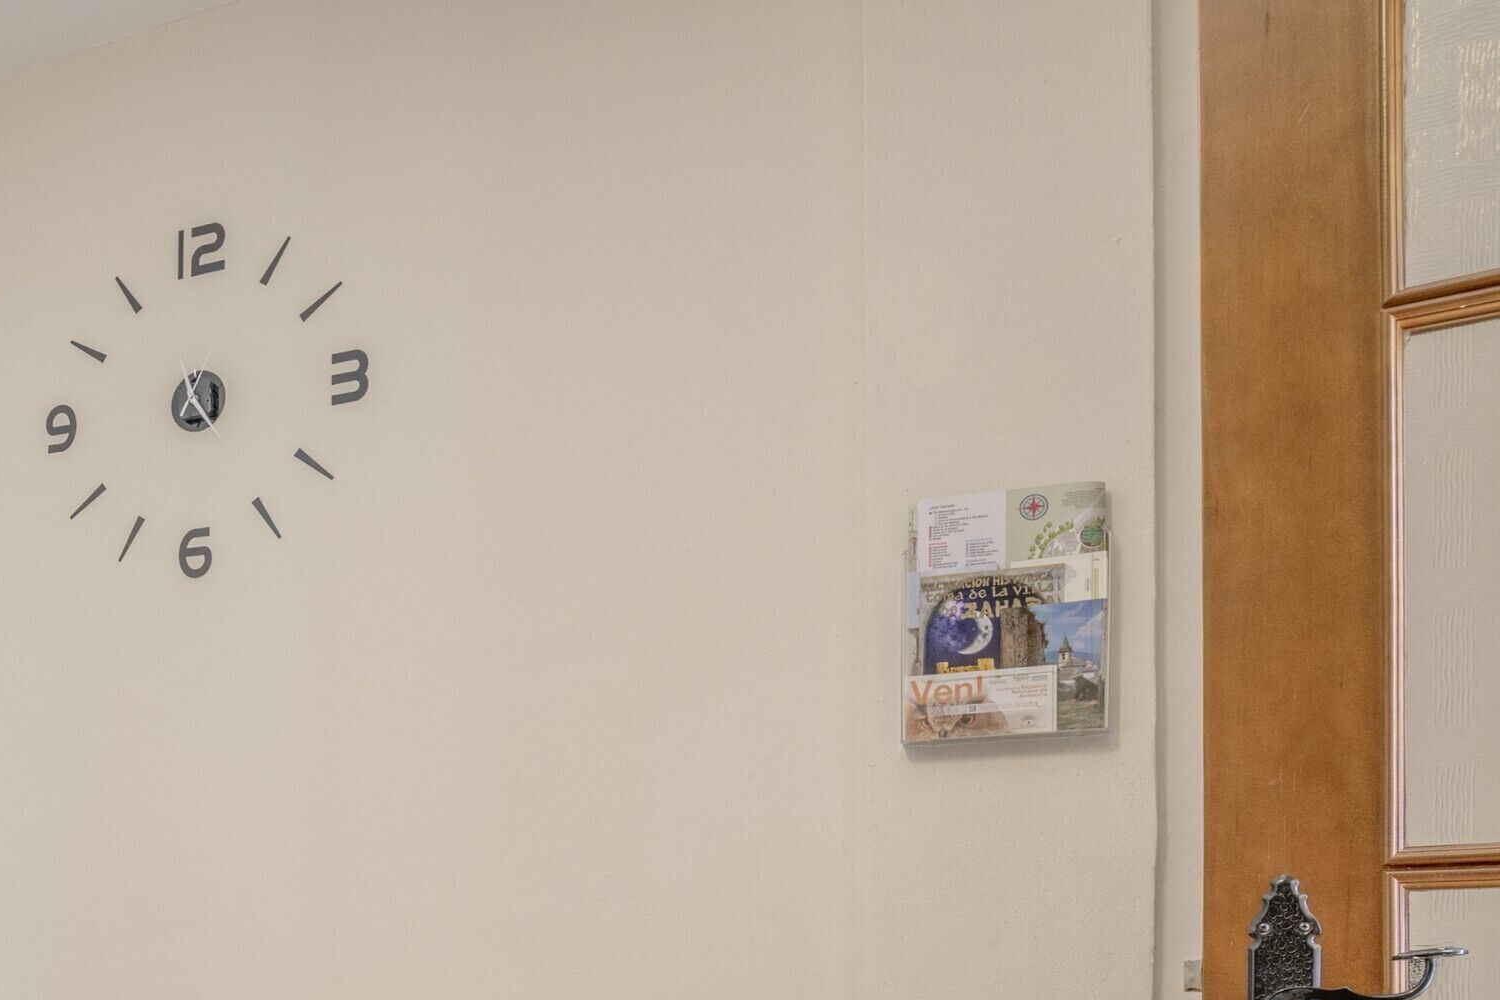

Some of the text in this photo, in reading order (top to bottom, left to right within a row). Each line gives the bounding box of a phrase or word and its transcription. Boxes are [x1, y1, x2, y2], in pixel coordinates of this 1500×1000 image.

[176, 222, 226, 280] 12
[331, 349, 370, 406] 3
[45, 404, 78, 454] 9
[178, 526, 213, 579] 6
[969, 589, 987, 600] de
[910, 676, 984, 705] Ven!
